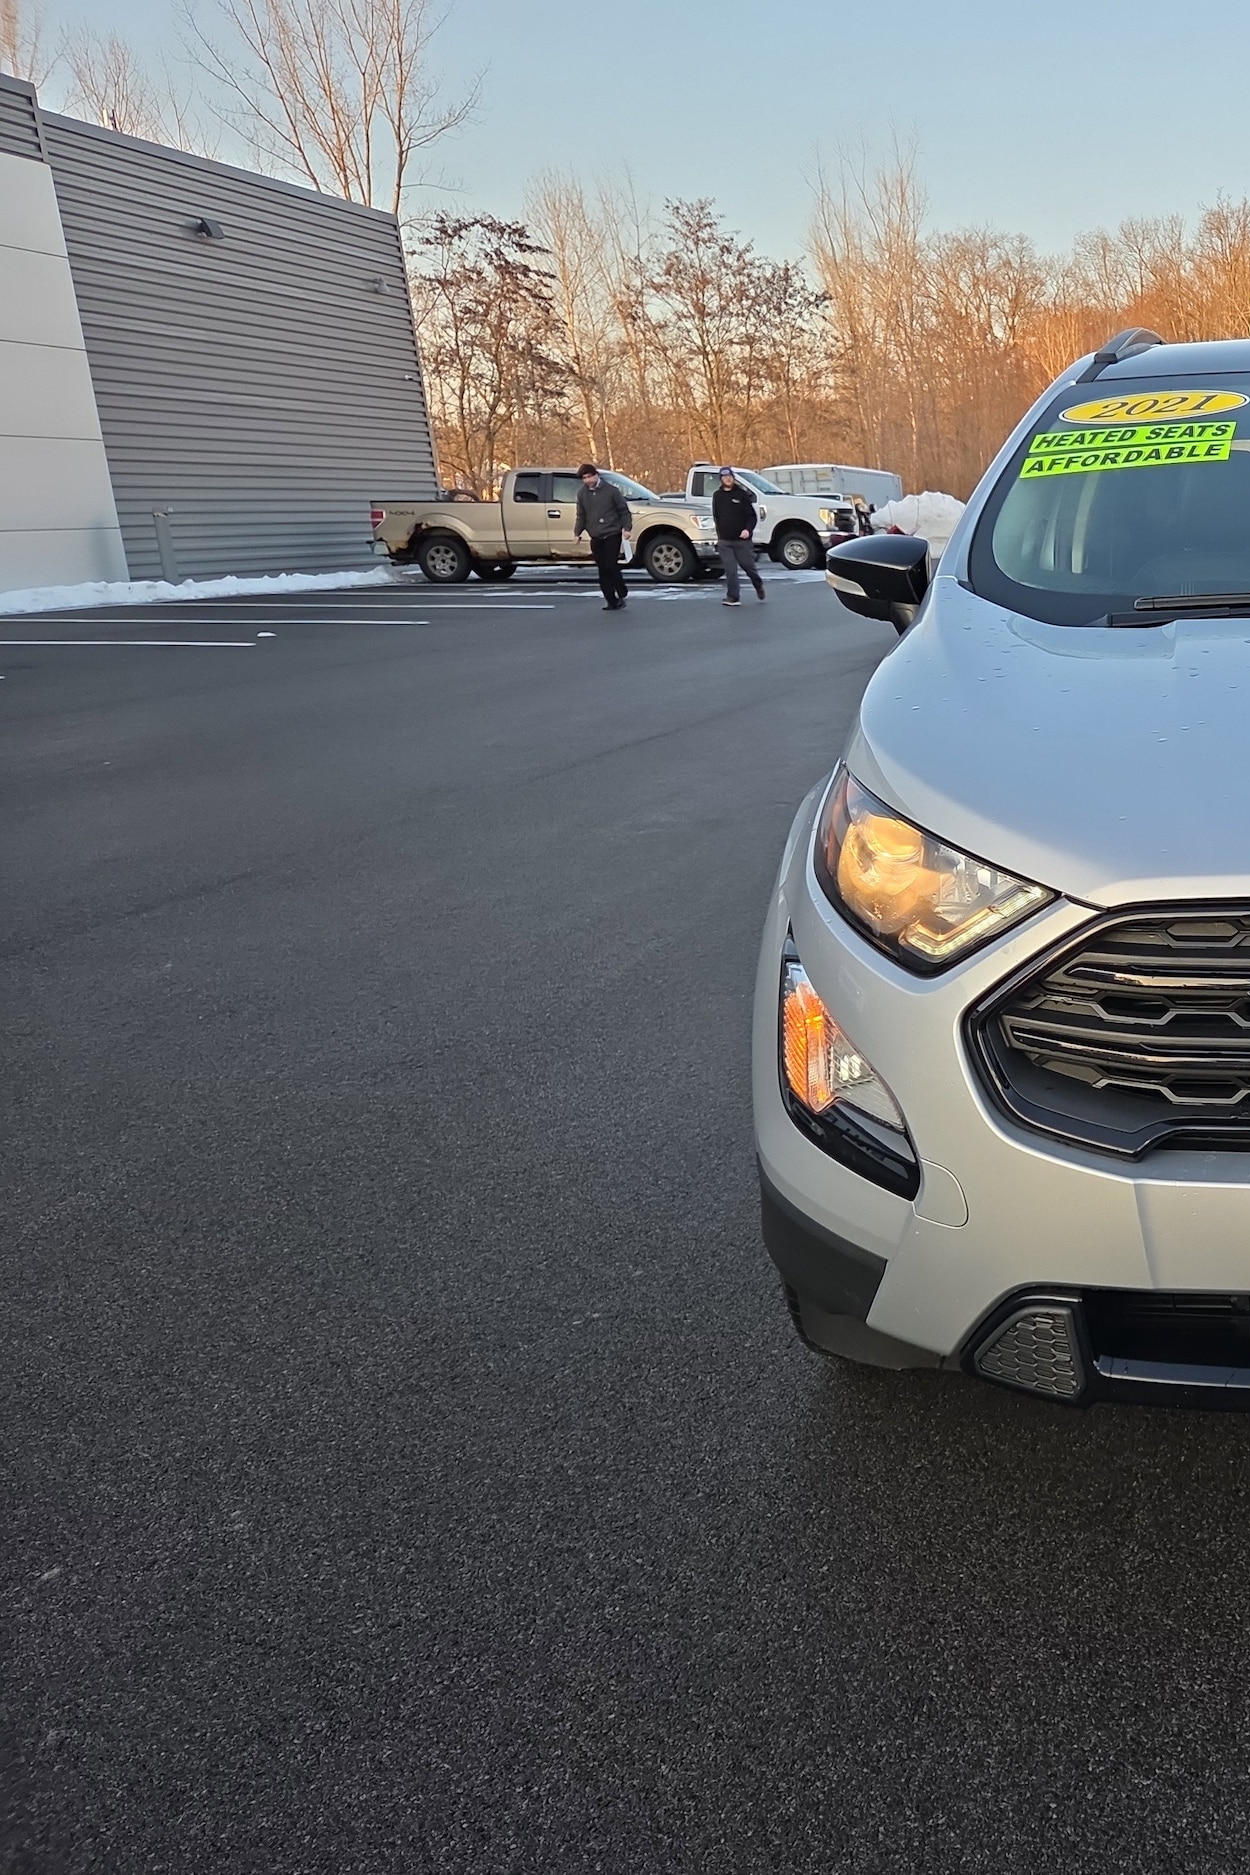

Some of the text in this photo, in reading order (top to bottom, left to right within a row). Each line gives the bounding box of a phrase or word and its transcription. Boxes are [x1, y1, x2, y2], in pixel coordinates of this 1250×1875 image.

[1089, 394, 1220, 420] 2021
[1033, 424, 1231, 450] HEATED SEATS
[1025, 443, 1225, 474] AFFORDABLE
